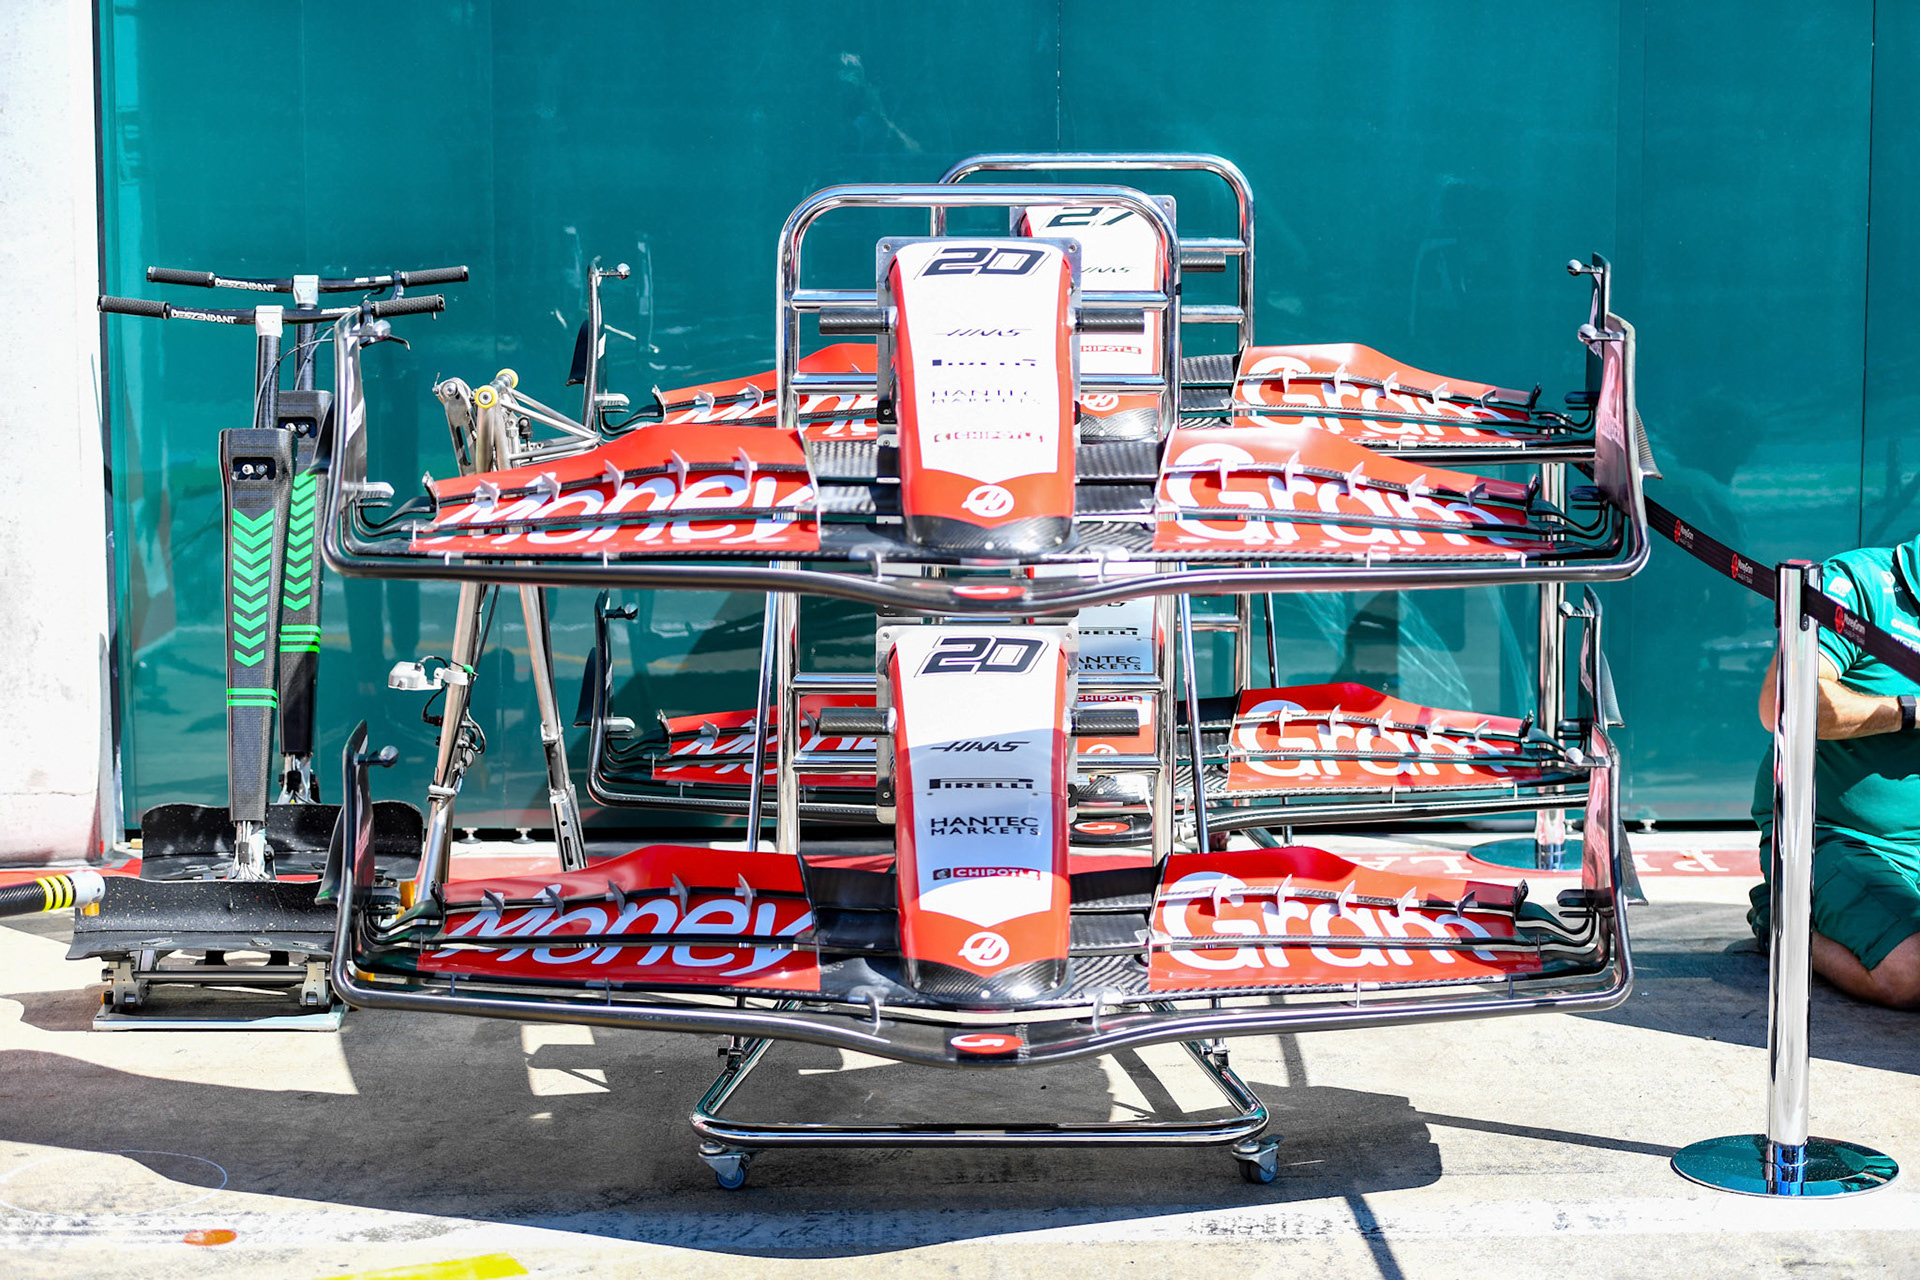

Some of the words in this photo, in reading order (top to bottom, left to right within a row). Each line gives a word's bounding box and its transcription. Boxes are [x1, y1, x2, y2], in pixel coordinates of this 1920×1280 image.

[918, 246, 1047, 279] 20
[1082, 345, 1141, 353] HIPOTLE
[1242, 356, 1514, 436] Gram
[425, 471, 814, 545] Money
[1166, 443, 1513, 546] Gram
[918, 636, 1047, 676] 20
[1078, 655, 1141, 664] NTEC
[930, 741, 1031, 752] HAAS
[1238, 700, 1508, 777] Gram
[929, 777, 1034, 789] PIRELLI
[930, 816, 1039, 828] HANTEC
[930, 826, 1039, 836] MARKETS
[955, 868, 1040, 880] CHIPOTLE
[432, 884, 813, 977] Money
[1163, 871, 1499, 970] Gram
